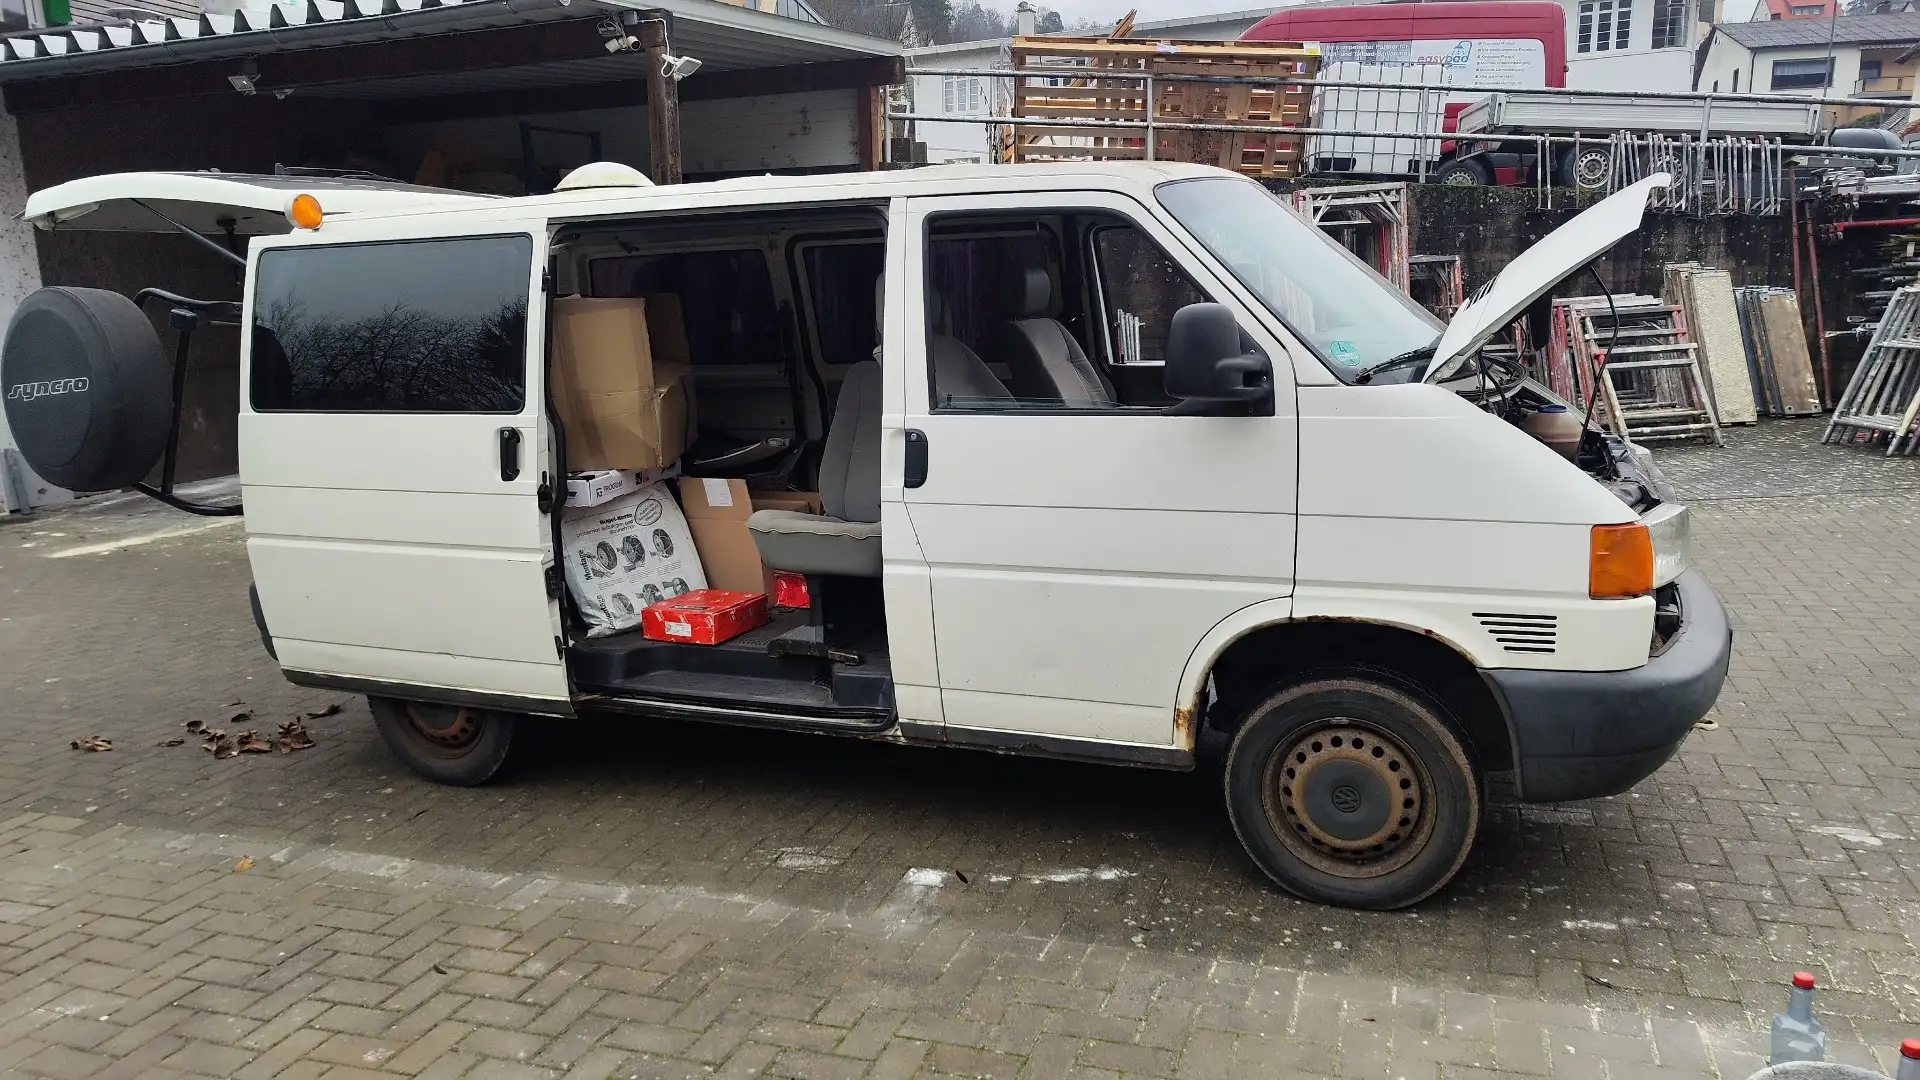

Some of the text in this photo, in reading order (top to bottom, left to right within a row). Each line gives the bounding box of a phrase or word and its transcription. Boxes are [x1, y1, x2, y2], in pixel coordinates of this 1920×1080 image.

[1417, 52, 1469, 65] easybad
[7, 376, 90, 402] syncro
[603, 481, 624, 492] FROGUM
[578, 549, 593, 581] Montage
